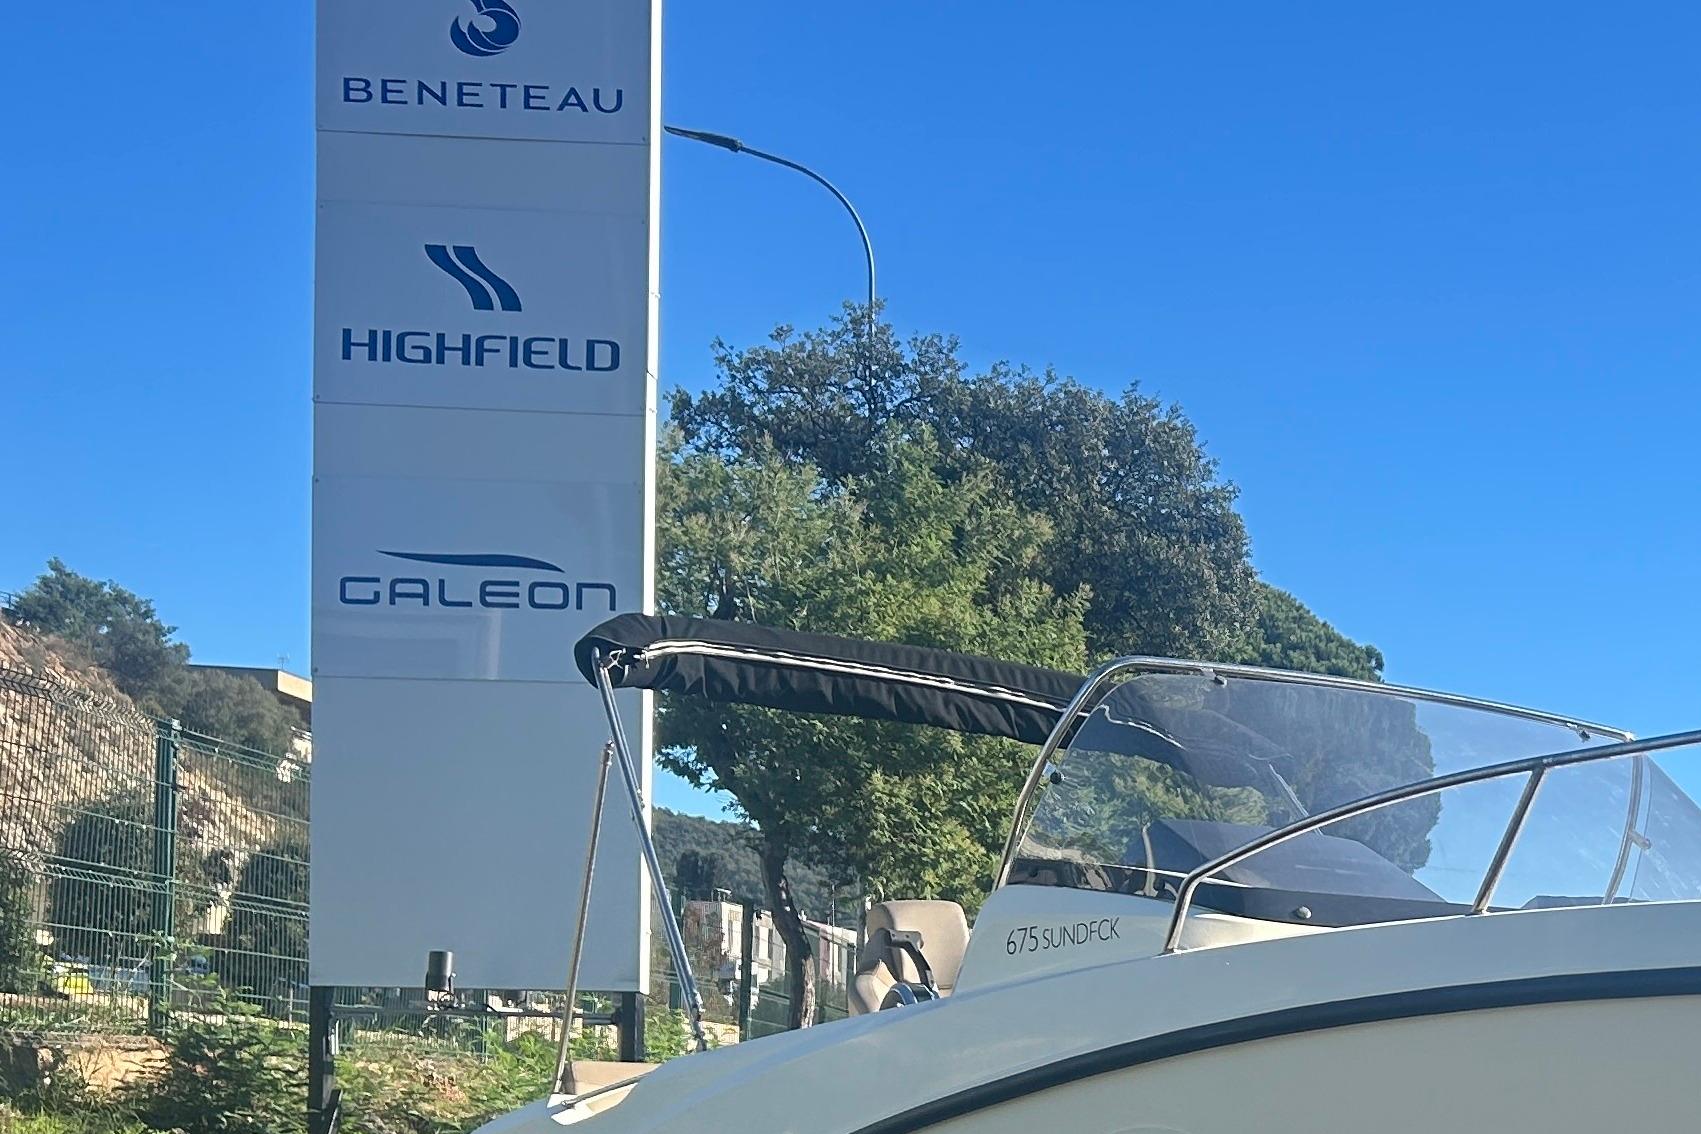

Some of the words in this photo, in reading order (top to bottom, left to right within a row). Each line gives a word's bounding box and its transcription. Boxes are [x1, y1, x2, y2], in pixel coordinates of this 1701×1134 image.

[343, 76, 624, 114] BENETEAU
[341, 327, 621, 372] HIGHFIELD
[339, 576, 617, 612] GALEON
[1006, 925, 1039, 955] 675
